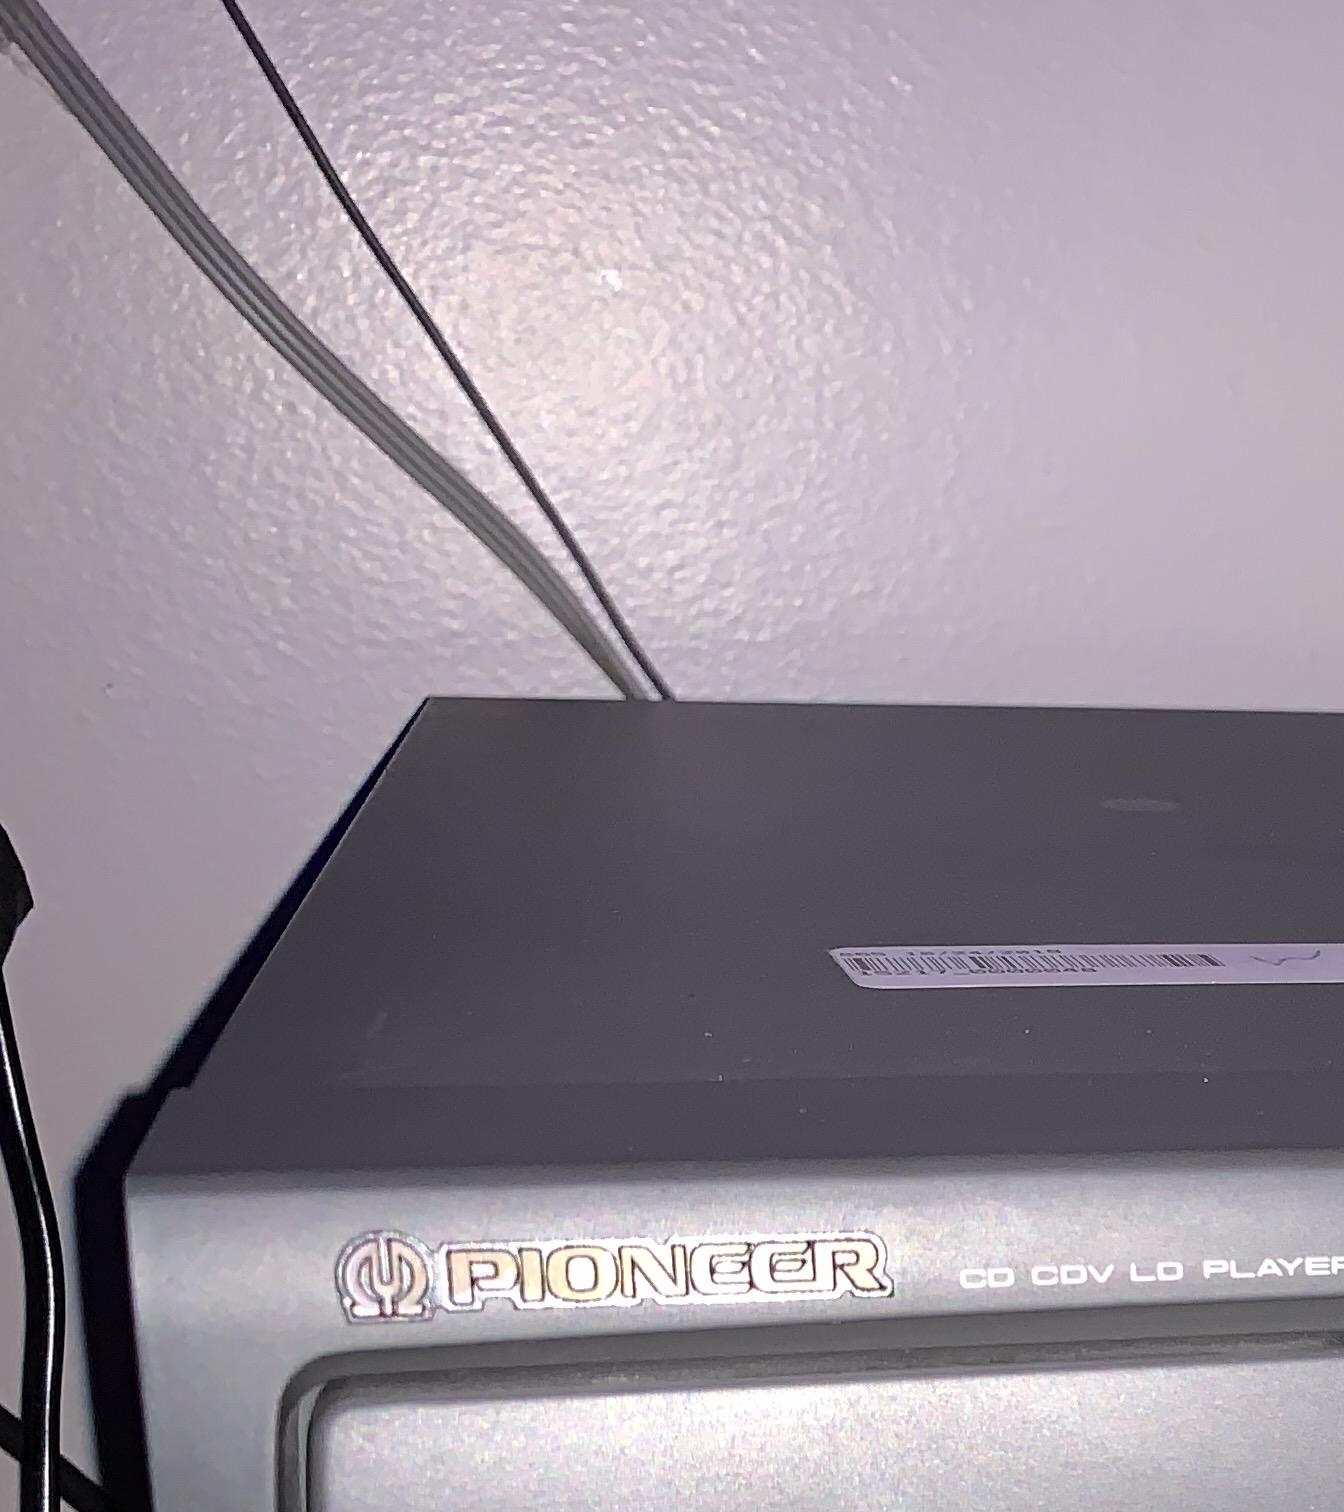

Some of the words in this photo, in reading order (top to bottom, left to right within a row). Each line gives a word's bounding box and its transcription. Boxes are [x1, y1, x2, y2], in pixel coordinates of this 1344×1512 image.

[443, 1231, 894, 1312] PIONEER
[959, 1266, 1015, 1289] CD
[1031, 1263, 1114, 1287] CDV
[1130, 1260, 1185, 1283] LD
